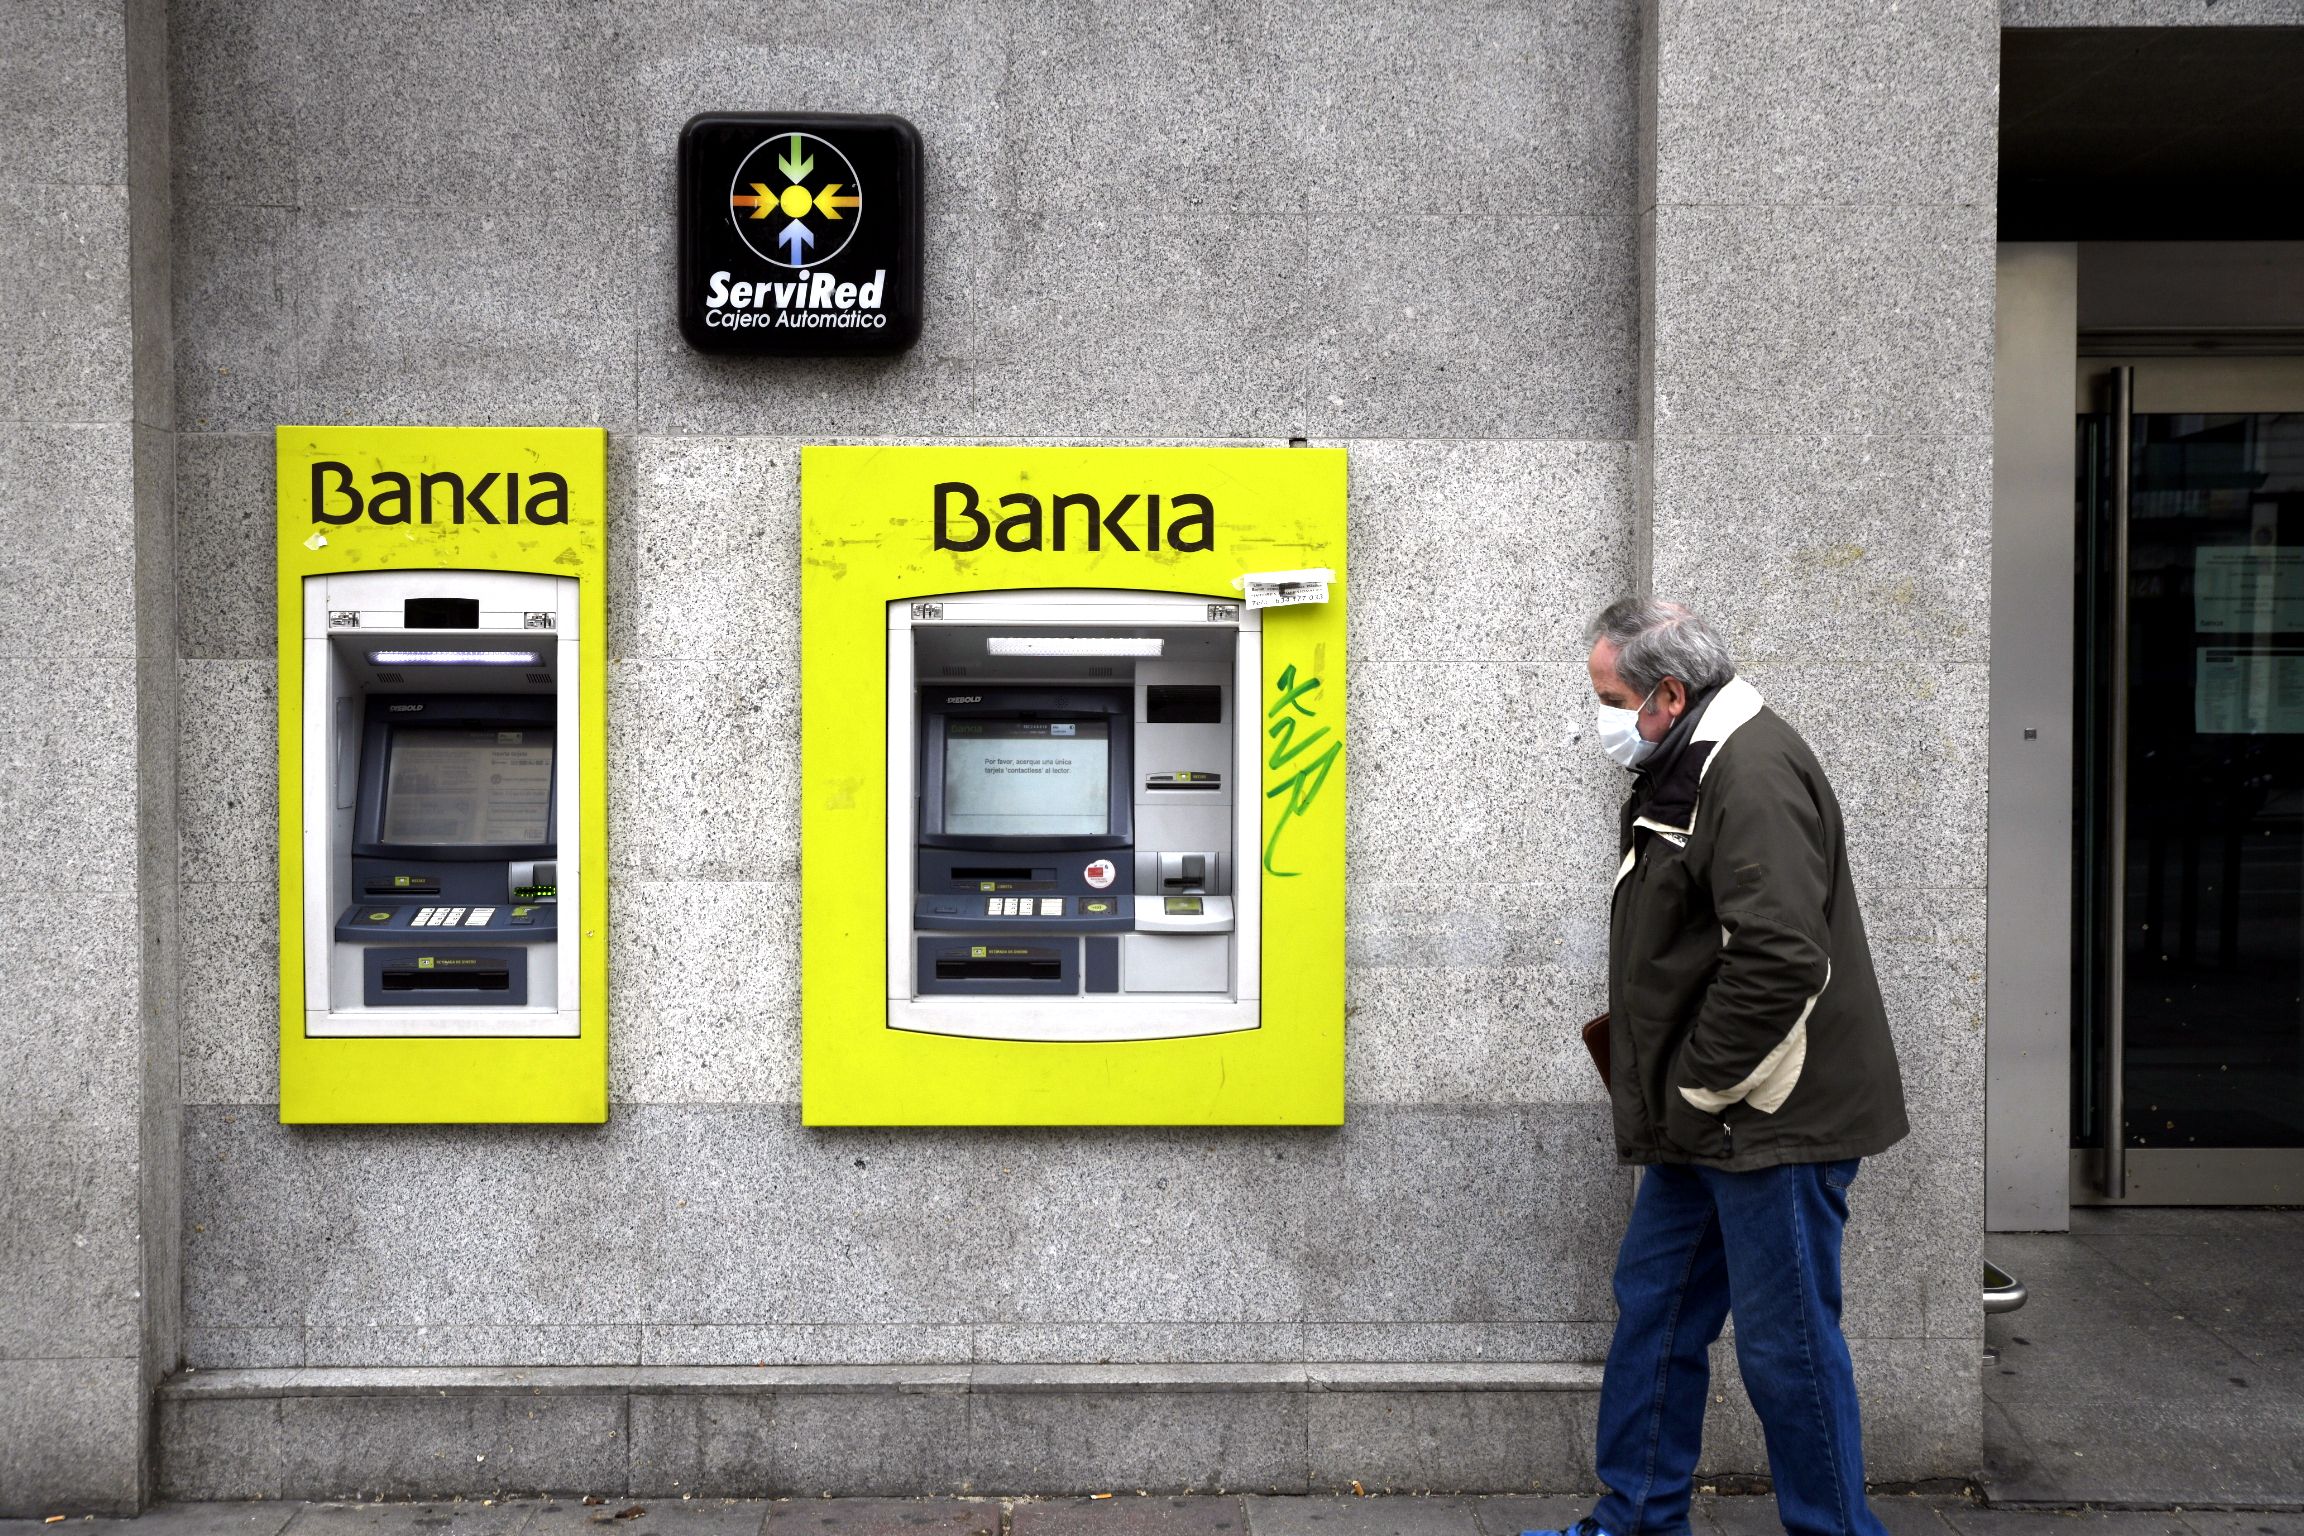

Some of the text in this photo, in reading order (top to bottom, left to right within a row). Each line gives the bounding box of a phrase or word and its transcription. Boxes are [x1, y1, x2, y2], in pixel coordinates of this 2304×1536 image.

[706, 269, 886, 309] ServiRed
[706, 309, 886, 331] Cajero Automático
[311, 461, 569, 525] Bankia
[933, 482, 1214, 552] Bankia
[947, 696, 982, 704] DIEBOLD
[389, 704, 424, 712] DIEBOLD
[997, 758, 1015, 766] favor,
[984, 767, 1004, 775] tarjeta
